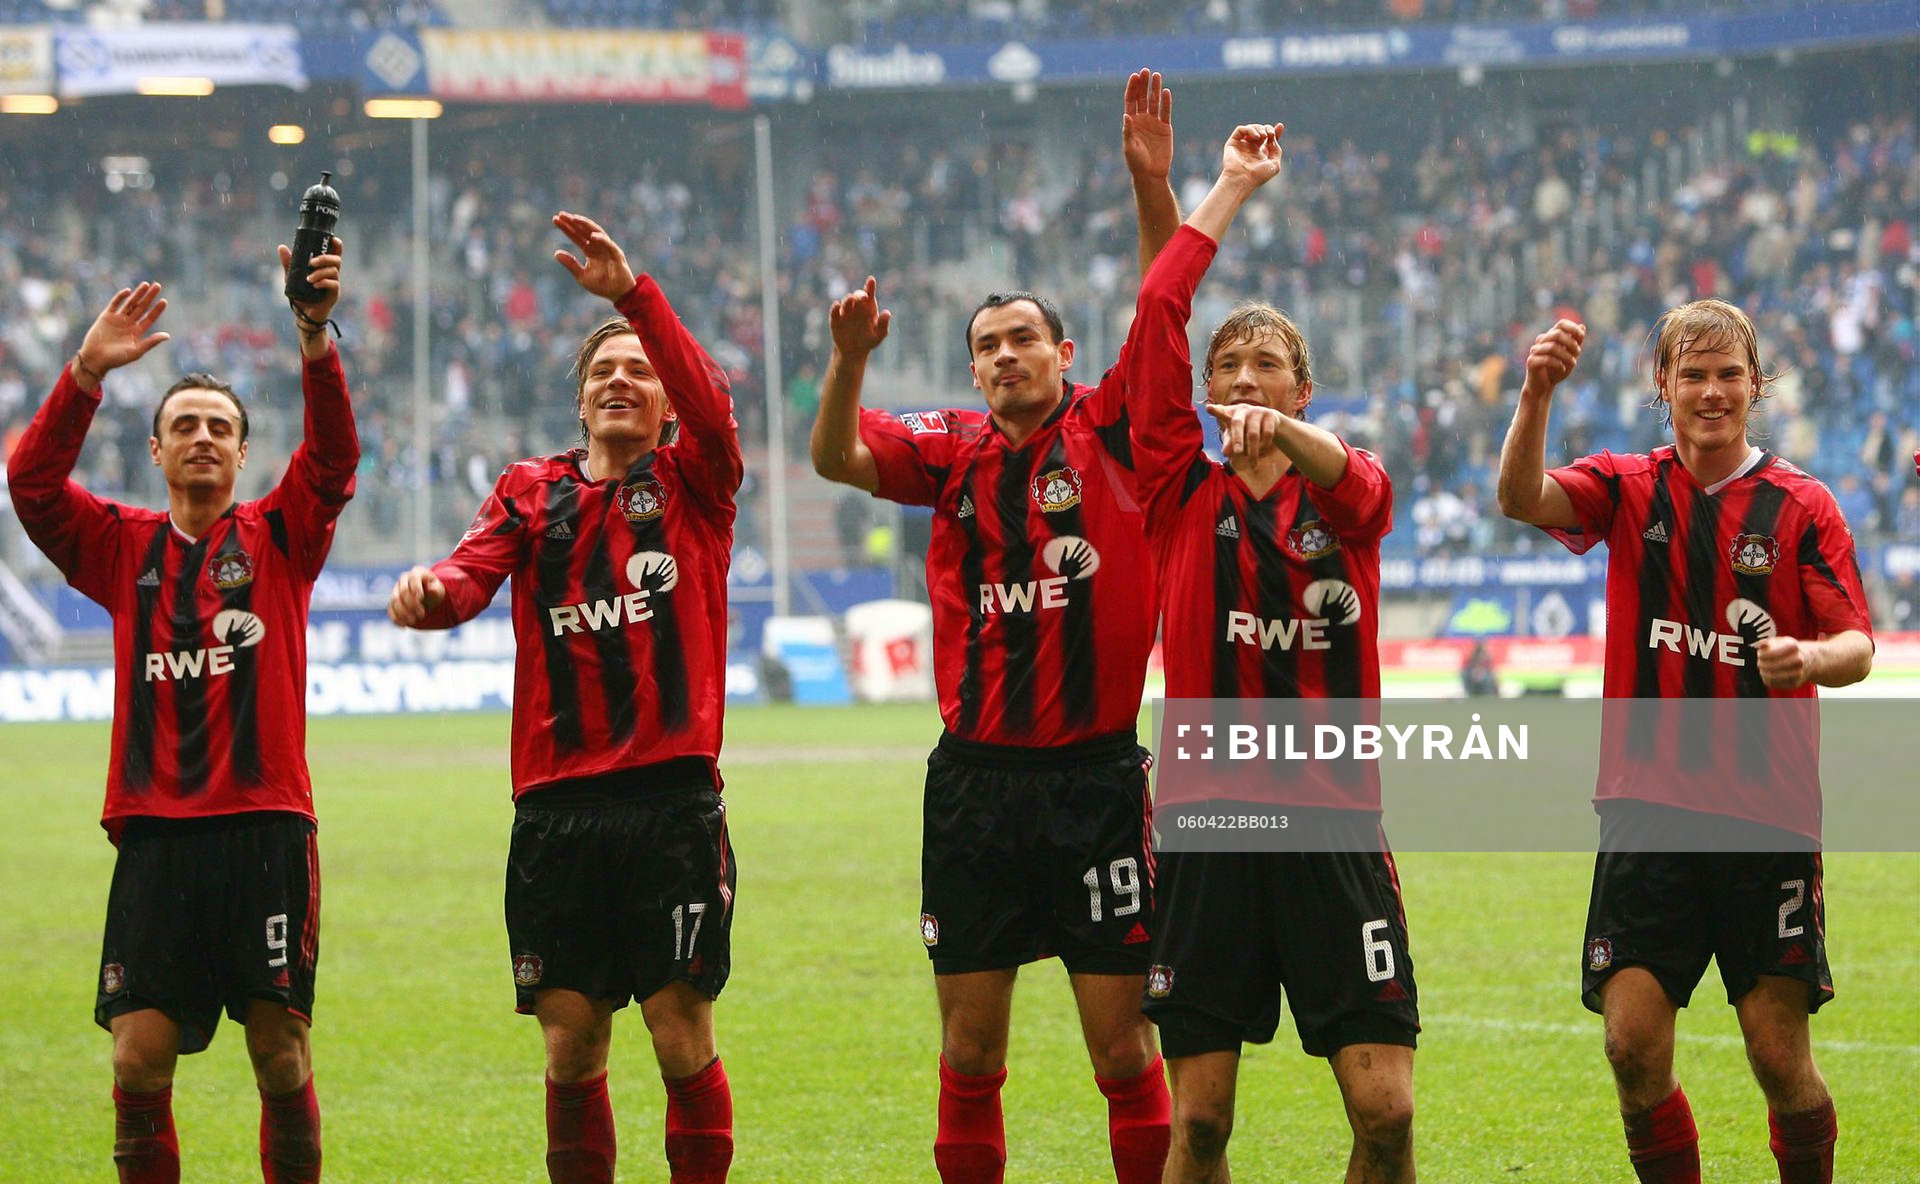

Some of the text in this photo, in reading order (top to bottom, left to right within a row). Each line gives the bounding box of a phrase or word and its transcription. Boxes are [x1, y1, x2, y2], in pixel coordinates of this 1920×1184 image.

[1215, 527, 1240, 539] adidas
[549, 590, 654, 637] RWE
[979, 576, 1070, 614] RWE
[1226, 610, 1331, 651] RWE
[1649, 618, 1746, 667] RWE
[145, 645, 235, 682] RWE
[1083, 857, 1140, 922] 19
[1778, 879, 1805, 938] 2
[266, 913, 288, 967] 9
[672, 903, 708, 960] 17
[1362, 919, 1395, 982] 6
